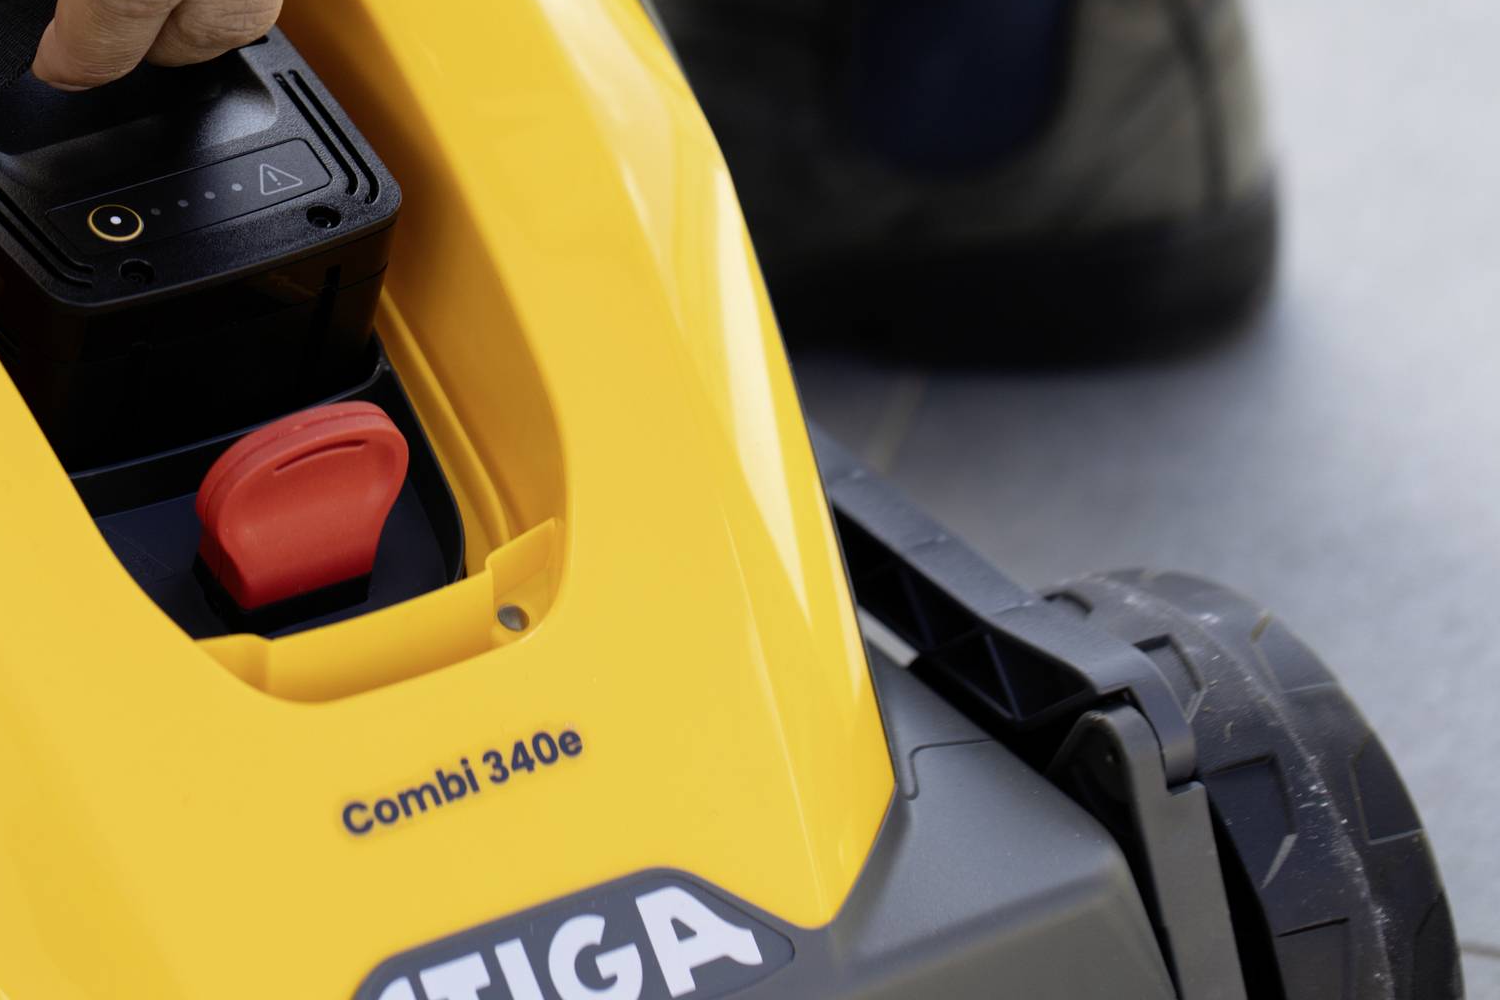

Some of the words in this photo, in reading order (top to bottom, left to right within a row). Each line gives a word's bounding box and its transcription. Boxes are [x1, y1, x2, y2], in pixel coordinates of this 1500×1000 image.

[342, 758, 480, 836] Combi
[482, 729, 584, 784] 340e
[377, 886, 763, 1000] IGA
